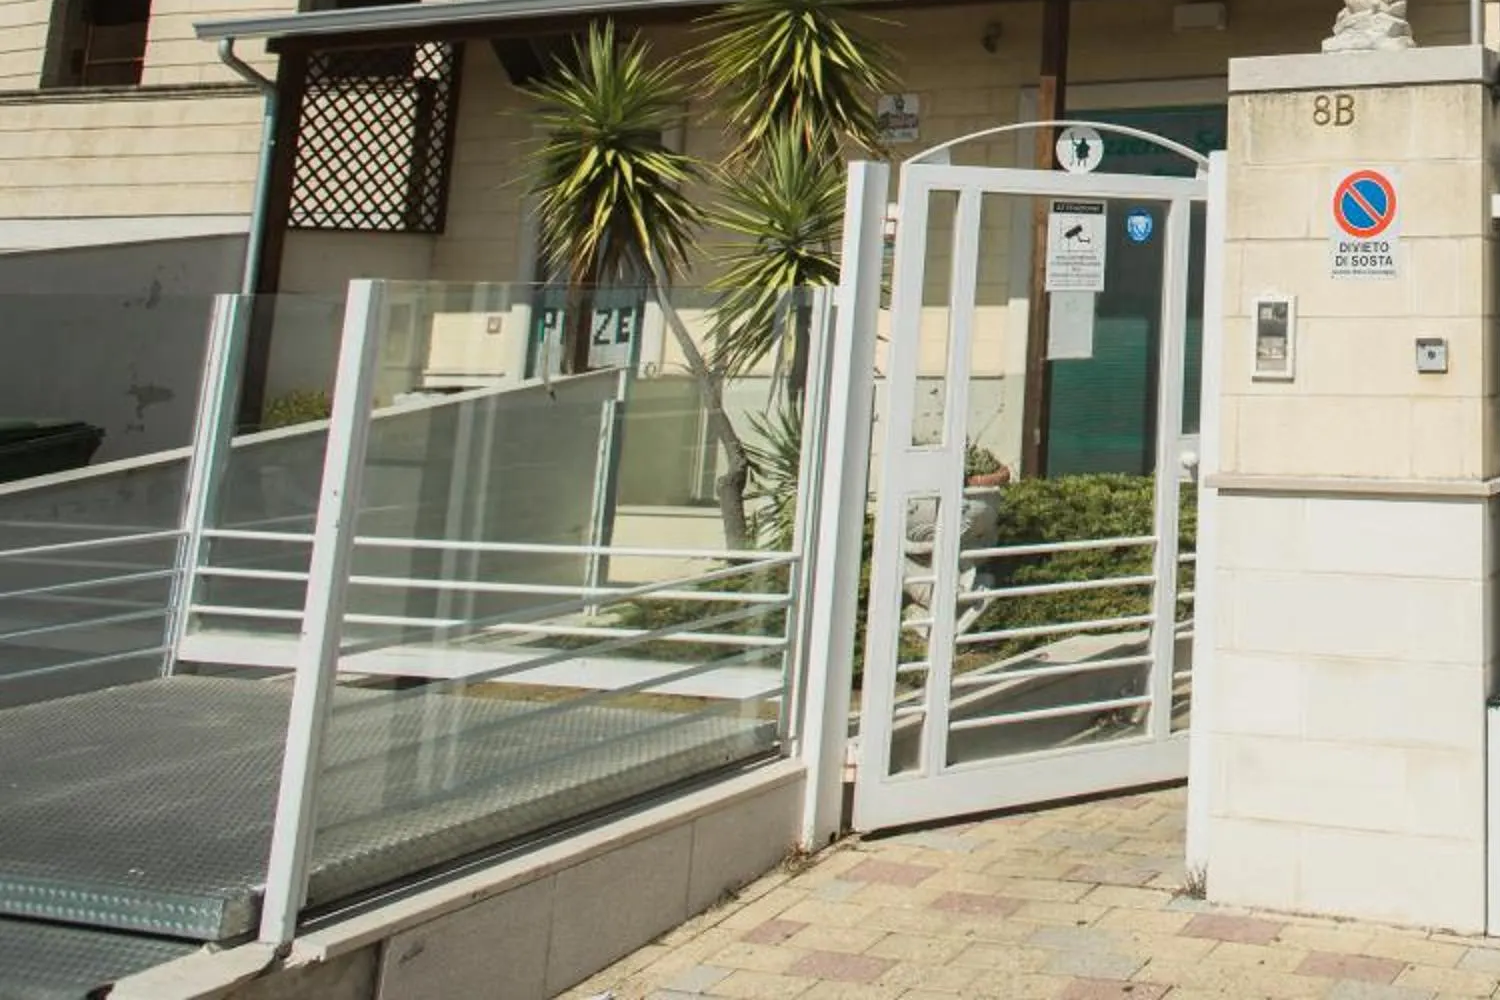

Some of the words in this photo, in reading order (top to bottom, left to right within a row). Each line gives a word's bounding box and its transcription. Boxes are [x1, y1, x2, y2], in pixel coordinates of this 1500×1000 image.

[1313, 95, 1355, 127] 8B
[1339, 241, 1390, 253] DIVIETO
[1335, 255, 1348, 267] DI
[1351, 255, 1394, 267] SOSTA
[538, 306, 633, 345] PIZE
